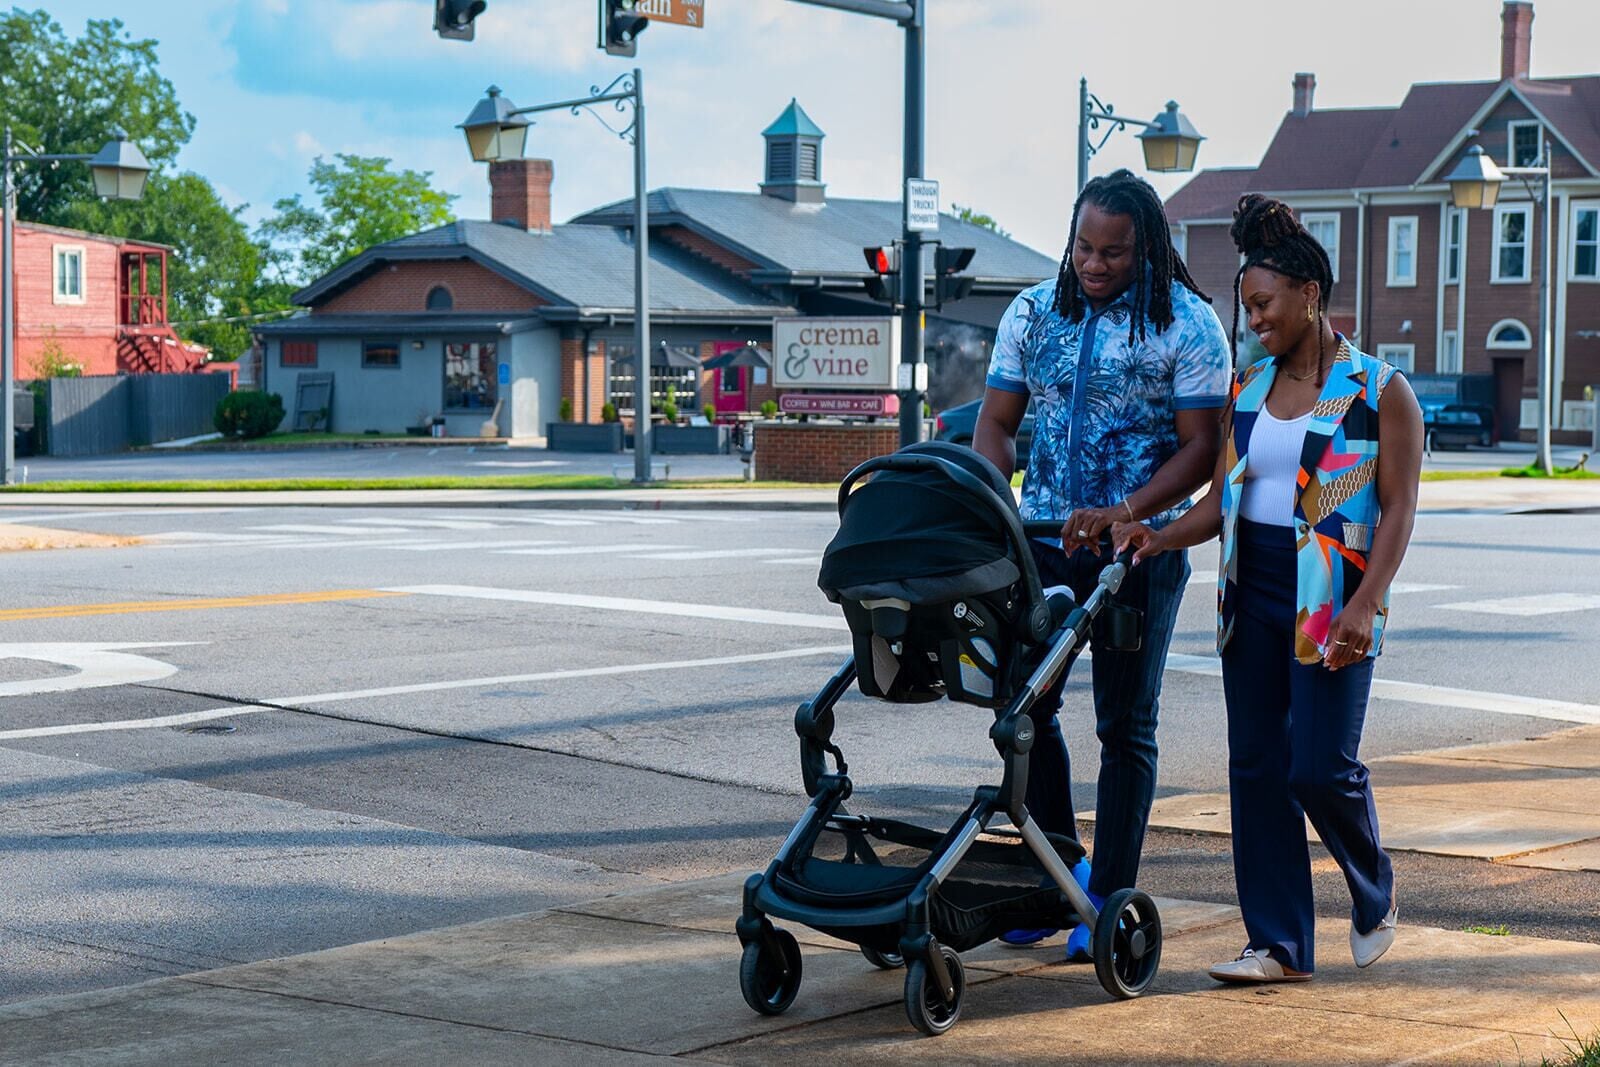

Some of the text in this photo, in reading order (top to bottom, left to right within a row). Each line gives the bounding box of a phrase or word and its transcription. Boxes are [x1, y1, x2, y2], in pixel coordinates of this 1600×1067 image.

[911, 186, 938, 196] THROUGH
[913, 199, 934, 209] TRUCKS
[800, 327, 880, 346] crema
[784, 342, 869, 380] & vine
[784, 399, 809, 408] COFFEE
[819, 400, 835, 409] WINE
[837, 400, 851, 409] BAR
